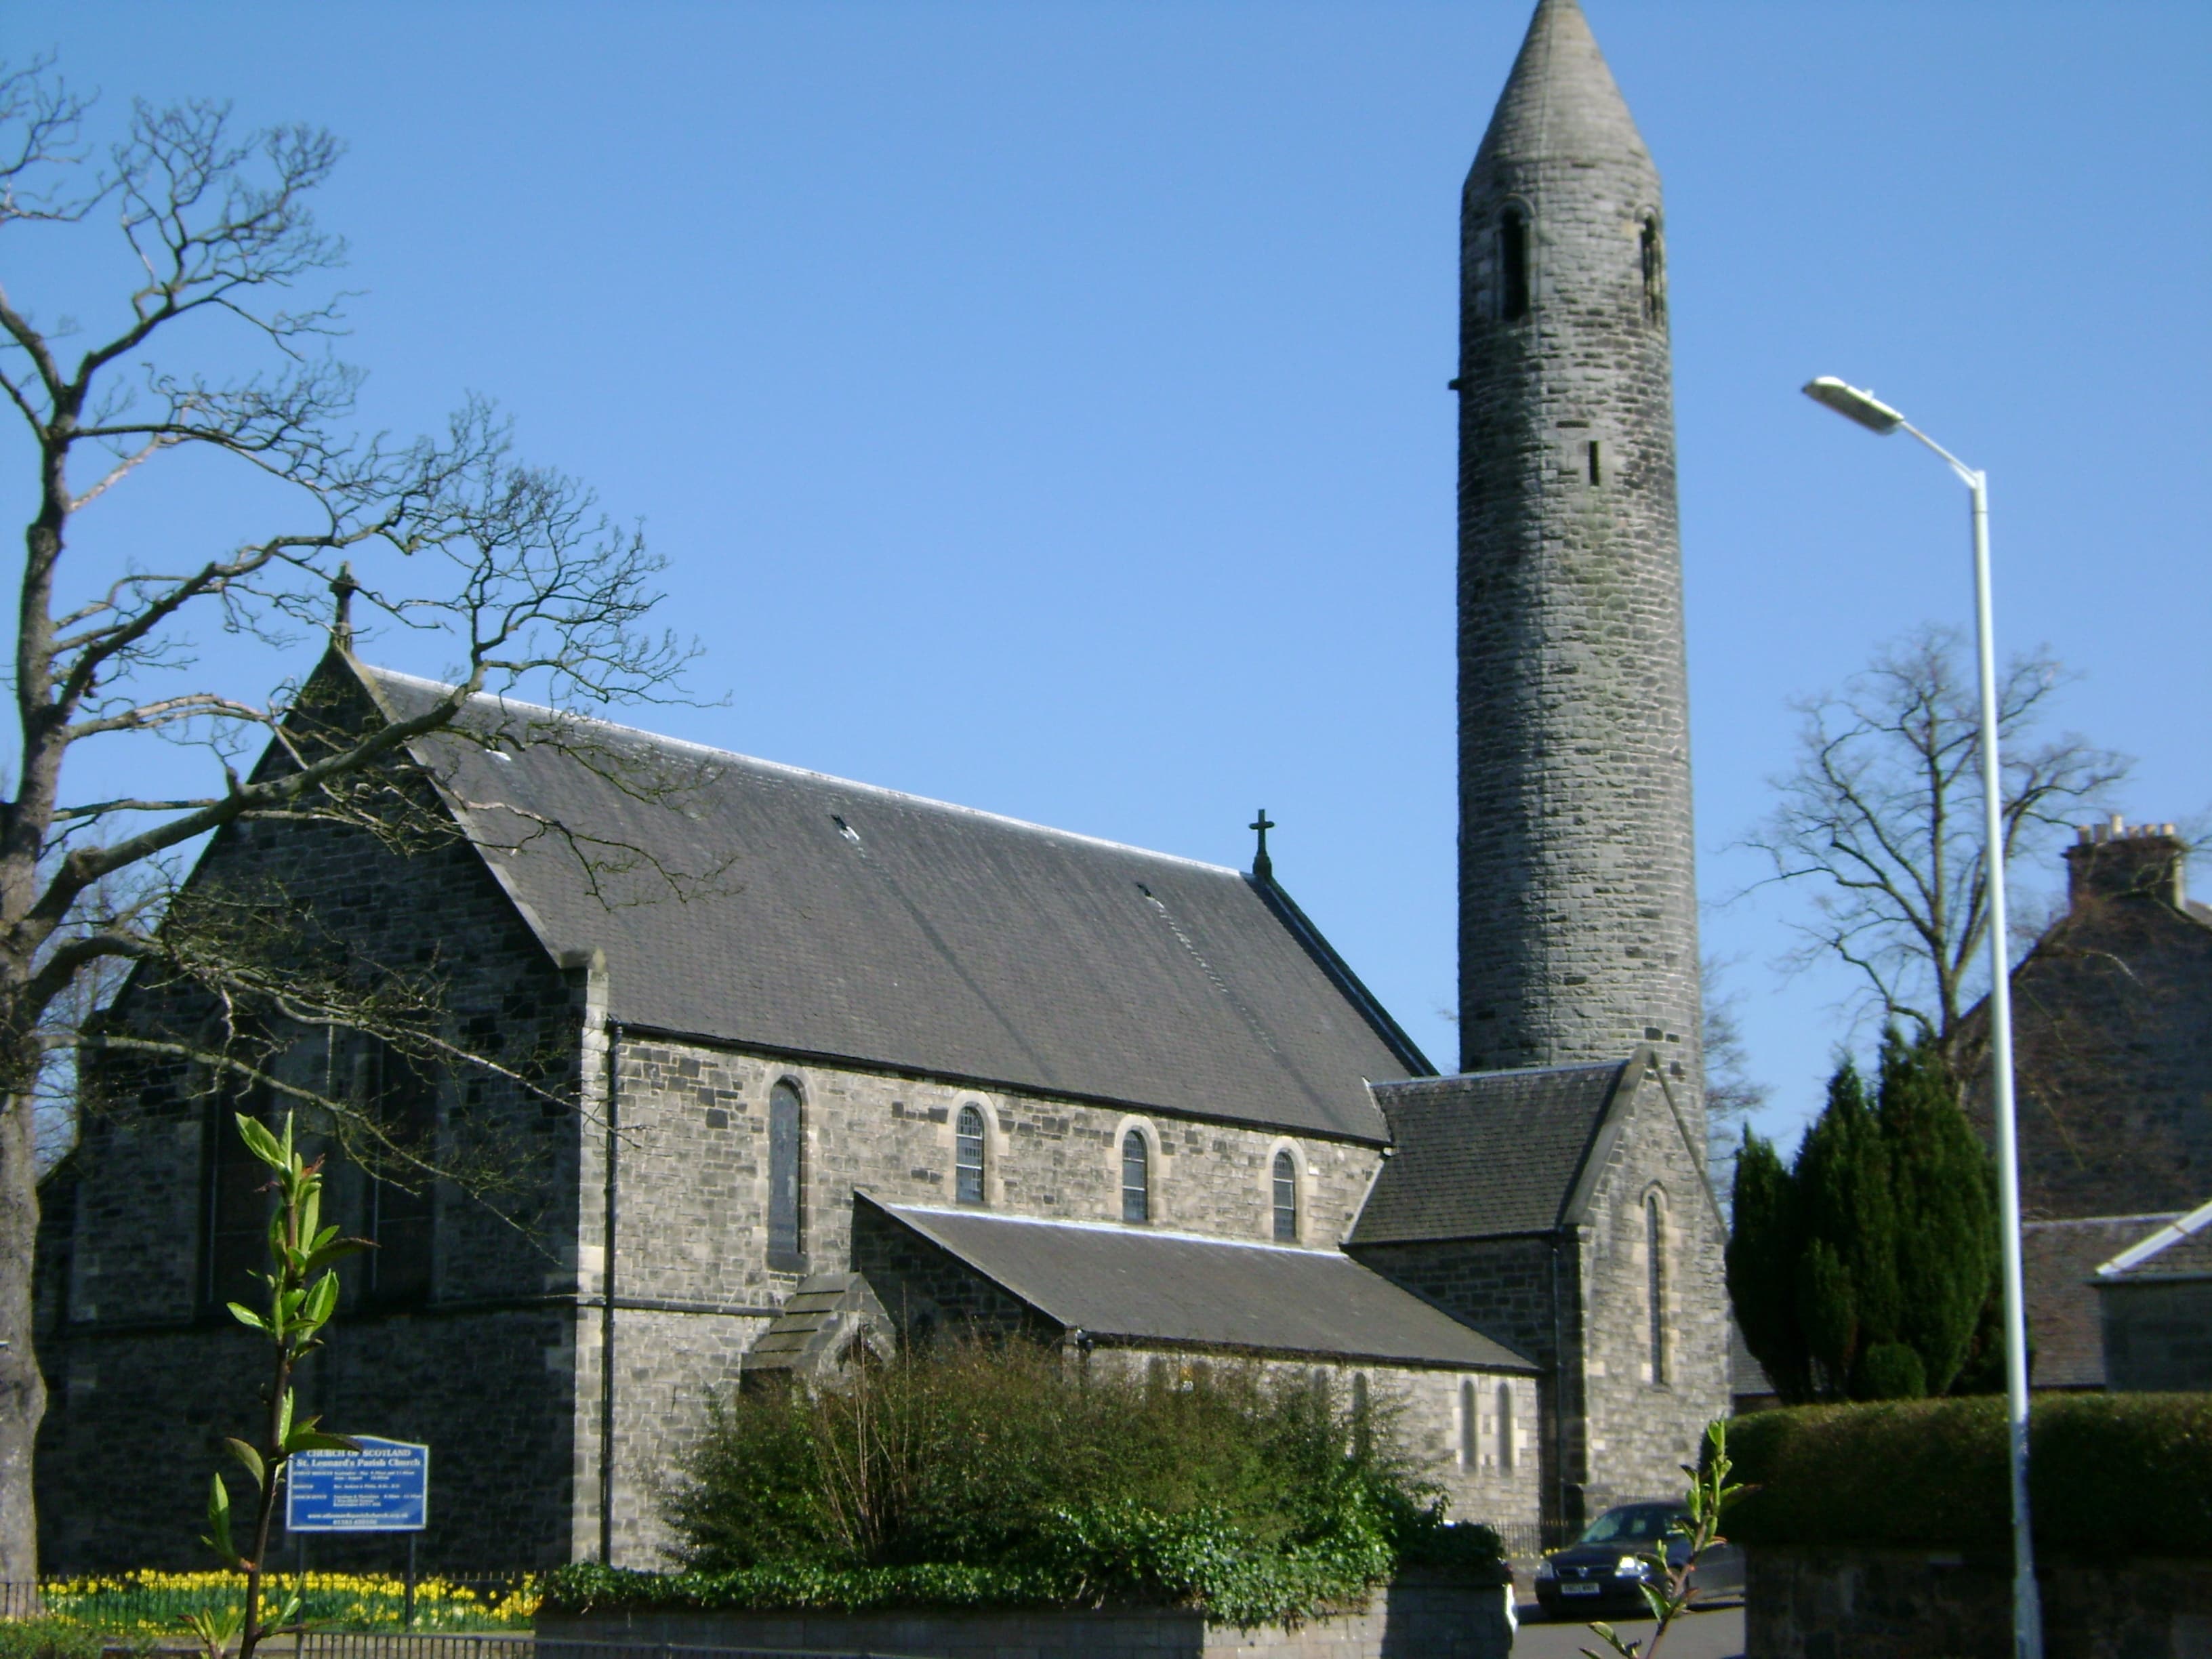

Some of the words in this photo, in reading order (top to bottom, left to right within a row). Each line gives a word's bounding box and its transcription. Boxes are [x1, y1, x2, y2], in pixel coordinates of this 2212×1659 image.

[306, 1449, 345, 1457] CHURCH
[363, 1449, 411, 1457] SCOTLAND
[312, 1459, 354, 1467] Leonard's
[388, 1458, 421, 1467] Church
